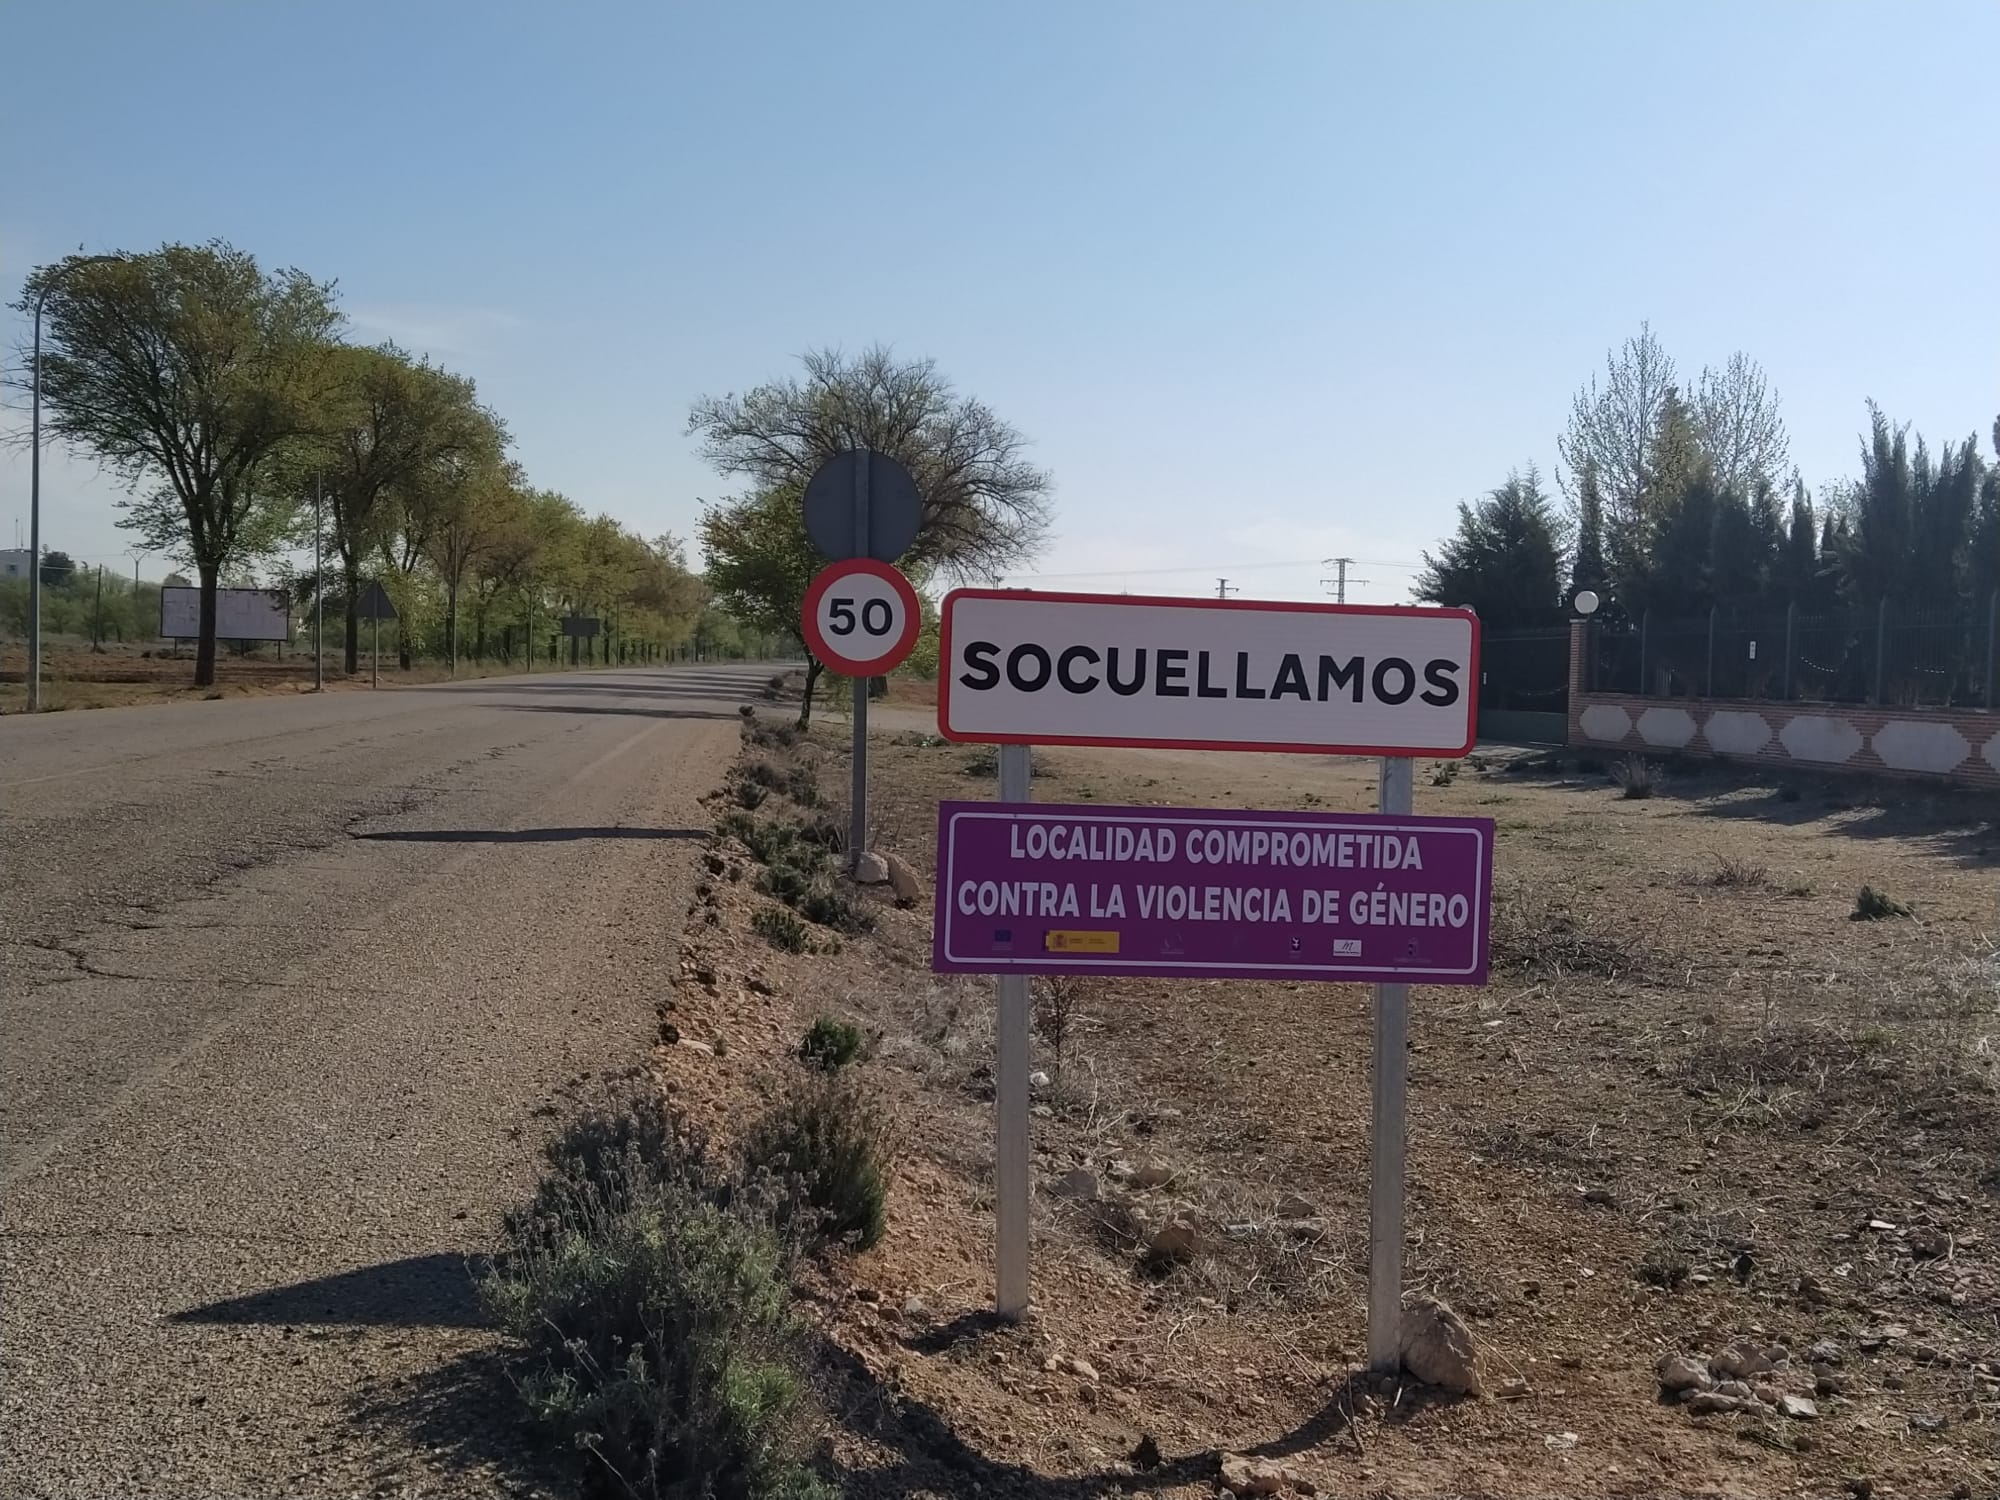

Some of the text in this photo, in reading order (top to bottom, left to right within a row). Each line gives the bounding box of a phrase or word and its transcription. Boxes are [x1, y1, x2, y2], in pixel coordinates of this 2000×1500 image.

[828, 598, 894, 637] 50
[959, 641, 1460, 708] SOCUELLAMOS
[1010, 824, 1423, 870] LOCALIDAD COMPROMETIDA
[958, 880, 1469, 928] CONTRA LA VIOLENCIA DE GÉNERO
